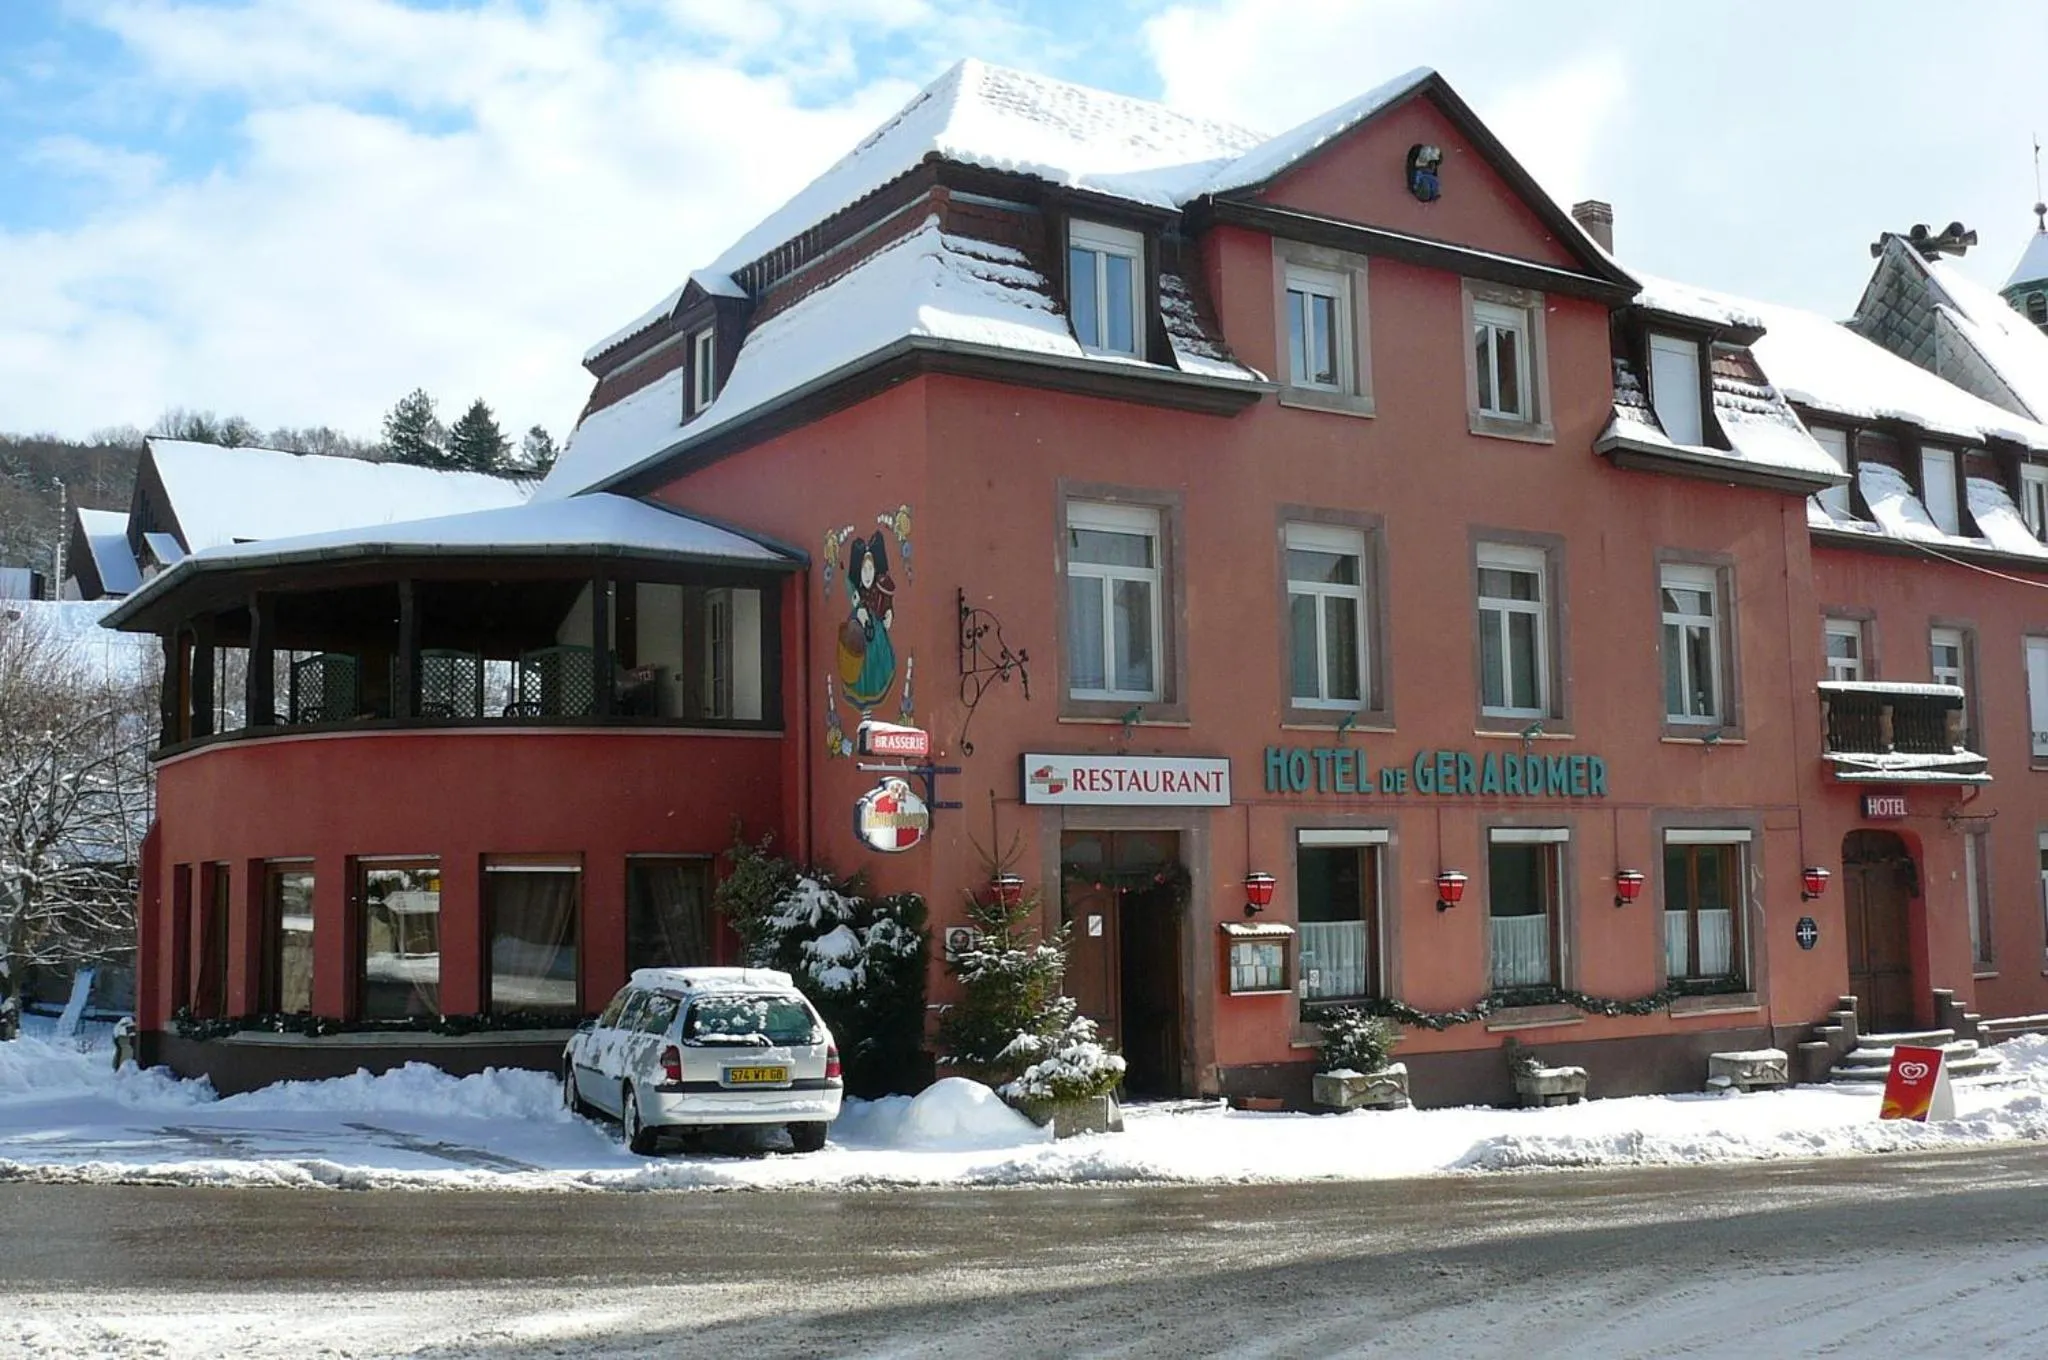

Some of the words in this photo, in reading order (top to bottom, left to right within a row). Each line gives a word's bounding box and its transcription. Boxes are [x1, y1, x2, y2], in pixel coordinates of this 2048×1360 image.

[874, 734, 926, 750] BRASSERIE
[1072, 768, 1225, 793] RESTAURANT
[1264, 746, 1374, 795] HOTEL
[1380, 768, 1409, 794] DE
[1413, 750, 1609, 797] GERARDMER
[1868, 798, 1909, 816] HOTEL
